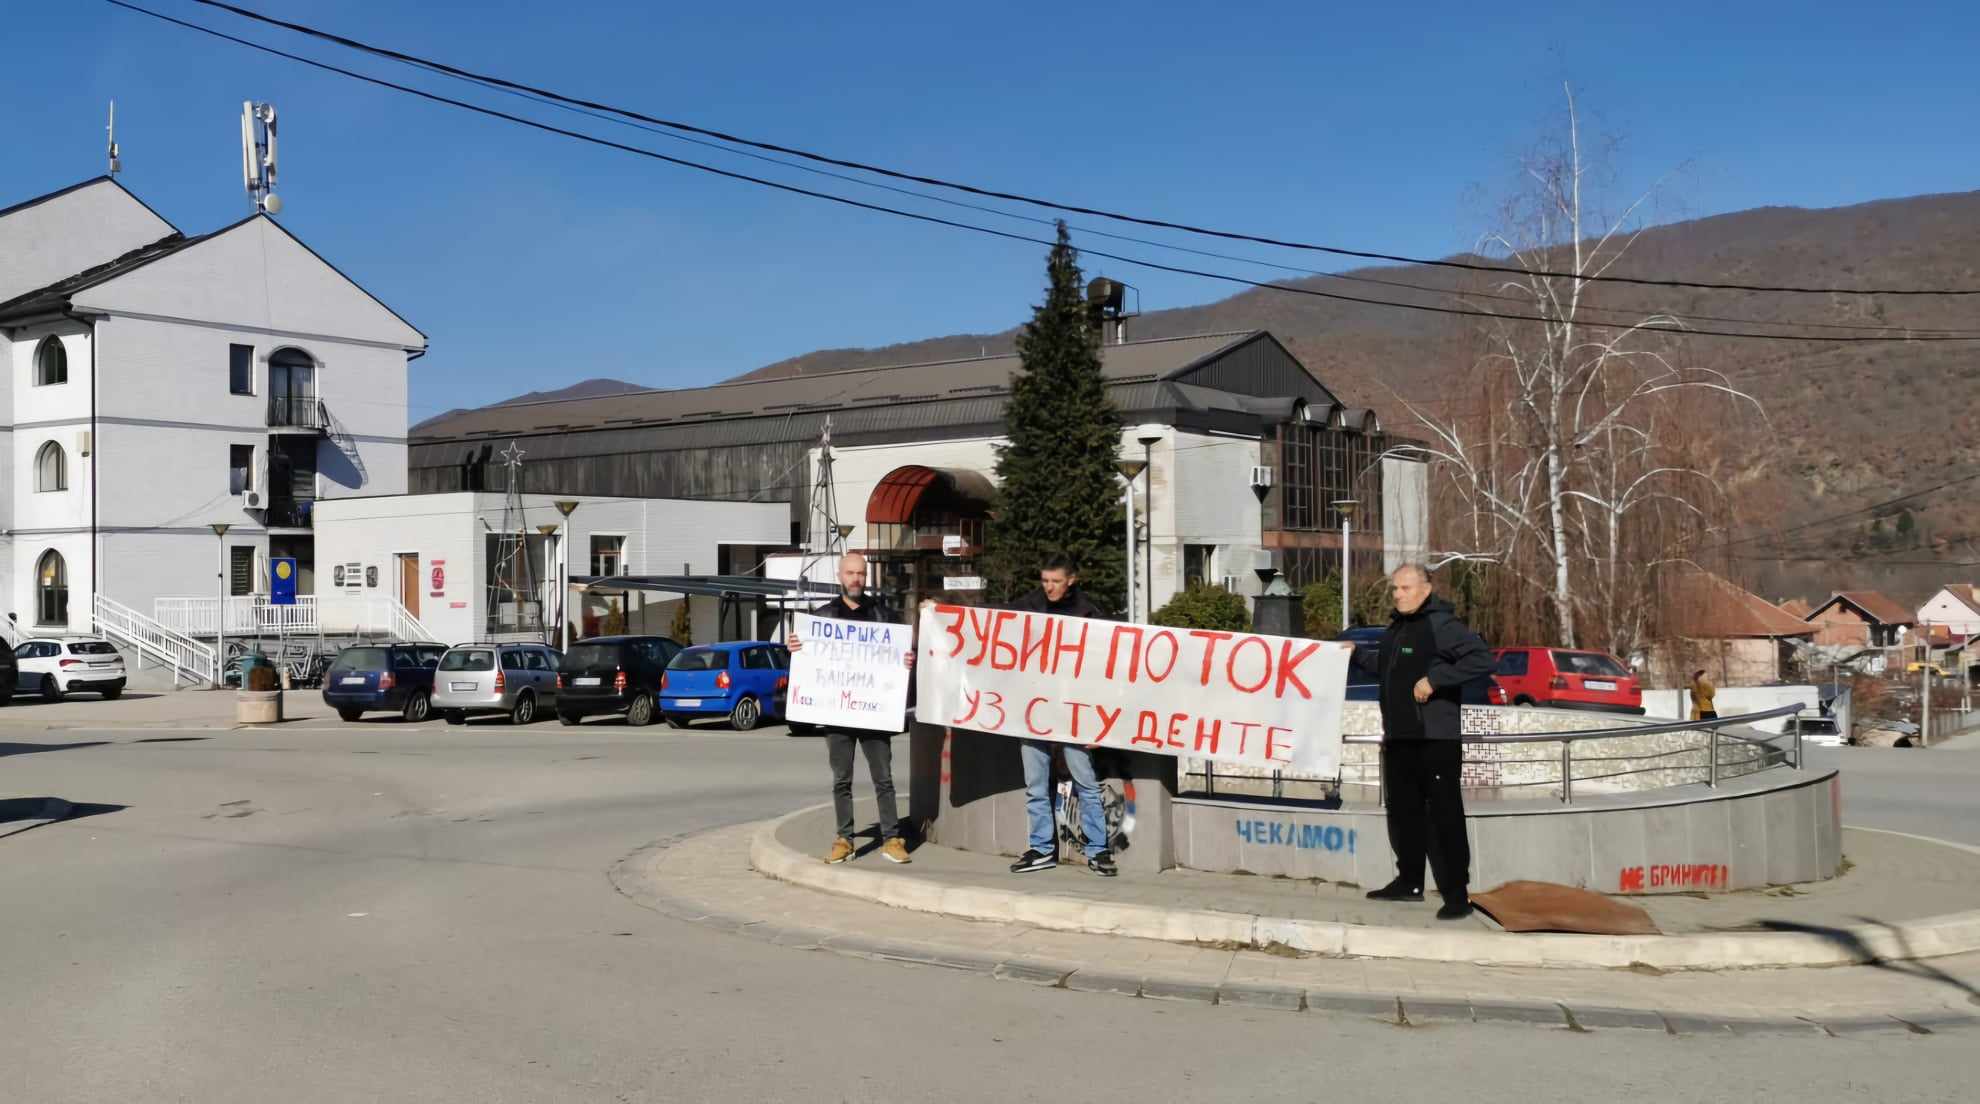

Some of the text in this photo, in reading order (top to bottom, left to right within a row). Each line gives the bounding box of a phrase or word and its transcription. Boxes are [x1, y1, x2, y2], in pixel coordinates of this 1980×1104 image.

[811, 621, 892, 644] ПОДРШКА
[934, 603, 1321, 700] ЗУБИН ПОТОК
[952, 686, 1294, 764] УЗ СТУДЕНТЕ
[1236, 819, 1357, 855] ЧЕКАМО!
